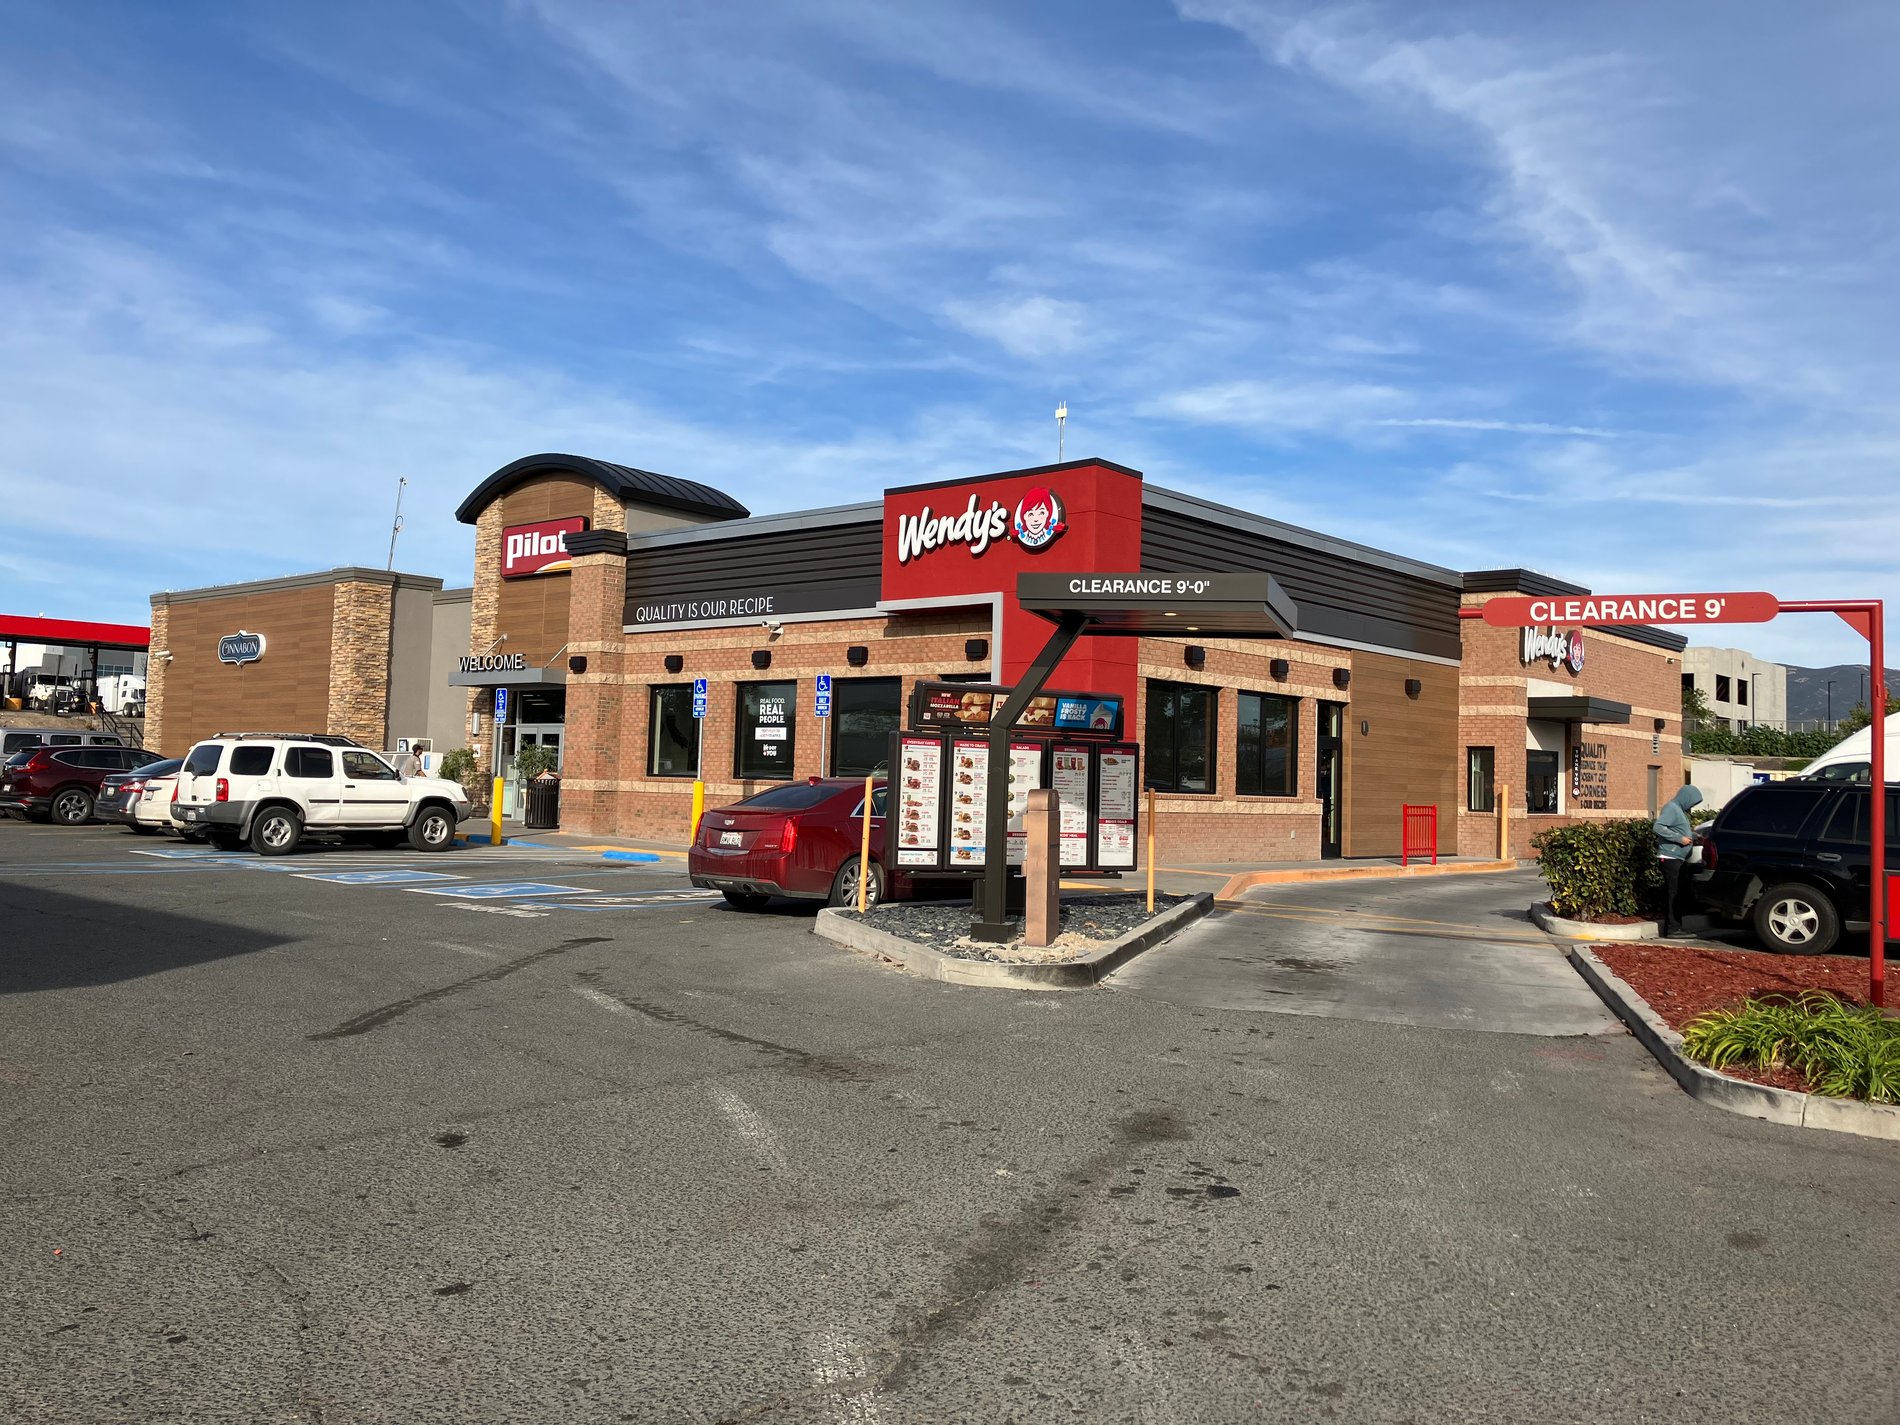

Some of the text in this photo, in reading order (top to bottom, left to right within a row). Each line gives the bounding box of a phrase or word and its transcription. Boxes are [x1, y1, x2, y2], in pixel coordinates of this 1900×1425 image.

[898, 493, 1008, 562] Wendy's
[506, 530, 568, 568] Pilot
[1069, 579, 1210, 594] CLEARANCE 9'-0"
[636, 596, 774, 622] QUALITY IS OUR RECIPE
[1529, 597, 1726, 622] CLEARANCE 9'
[1524, 626, 1568, 668] Wendy's
[458, 653, 524, 671] WELCOME
[759, 703, 784, 715] REAL
[931, 696, 960, 705] ITALIAN
[1062, 702, 1088, 710] VANILLA
